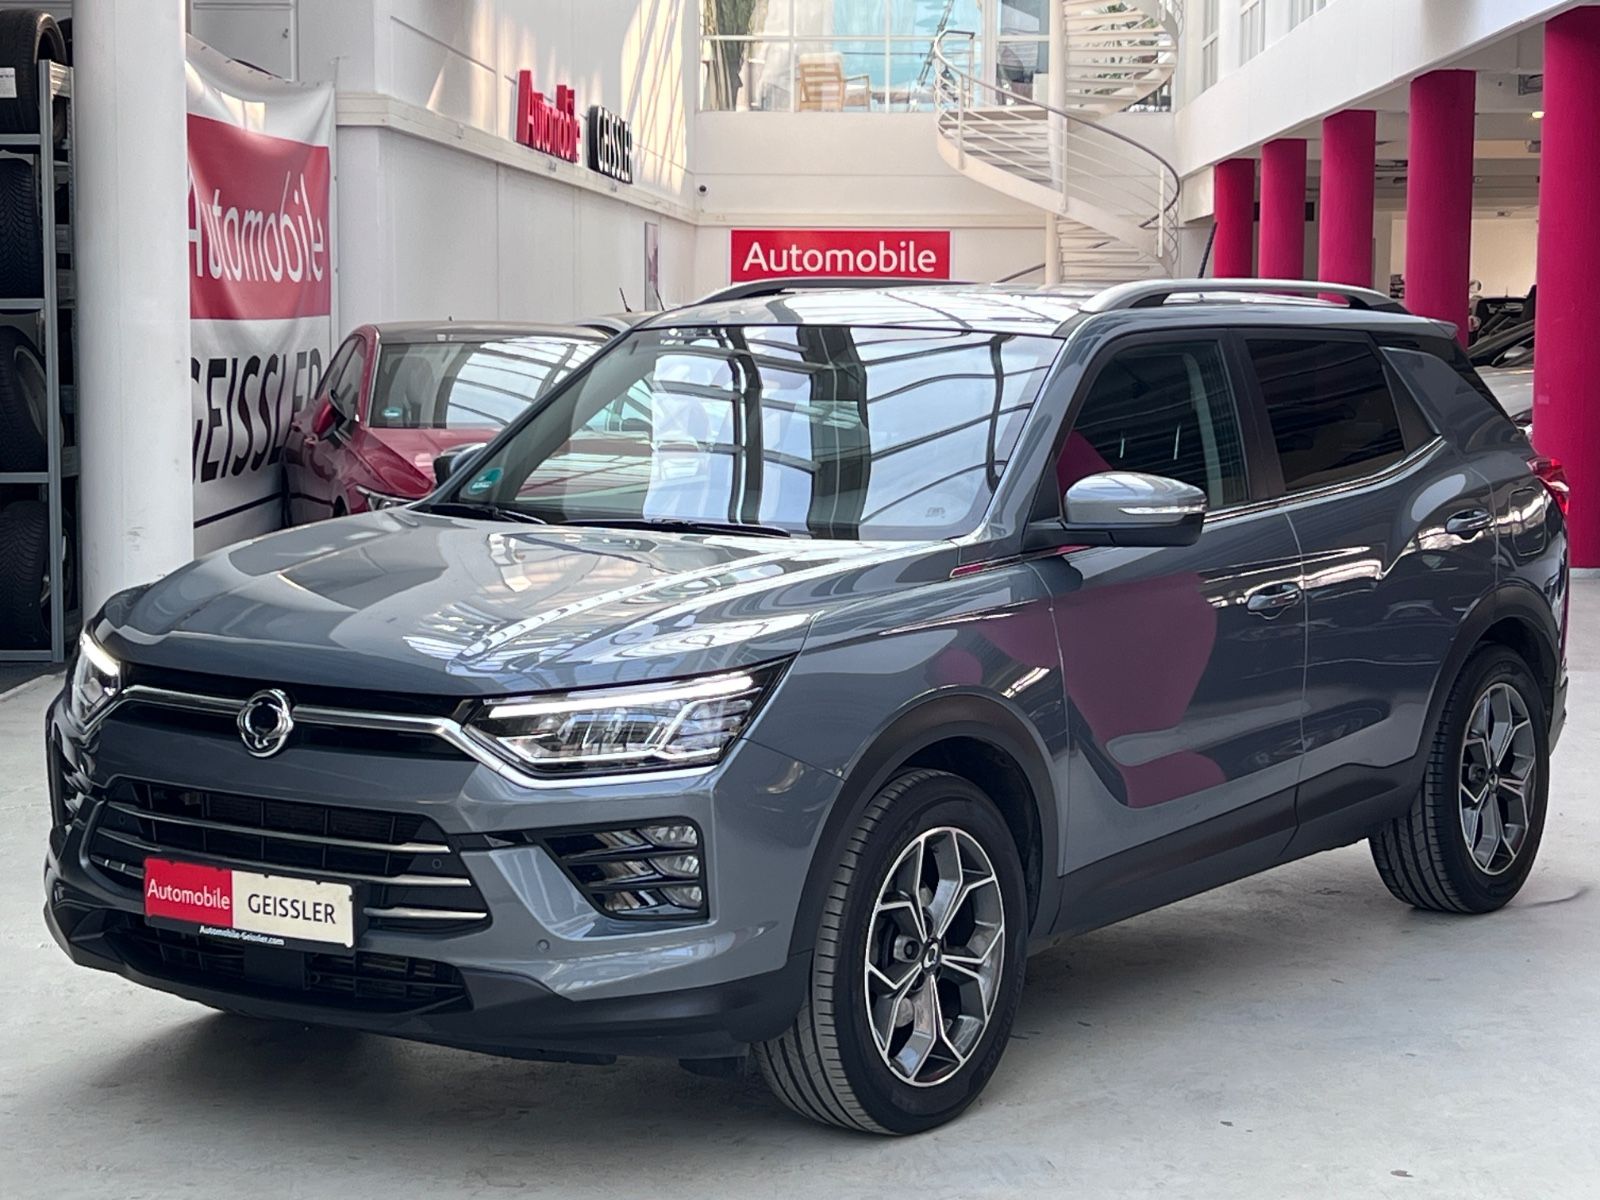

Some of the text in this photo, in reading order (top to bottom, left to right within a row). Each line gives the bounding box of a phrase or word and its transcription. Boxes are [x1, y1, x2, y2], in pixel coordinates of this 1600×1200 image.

[517, 70, 633, 184] Automobile GEISSLER
[742, 240, 937, 273] Automobile
[147, 878, 336, 924] Automobile GEISSLER
